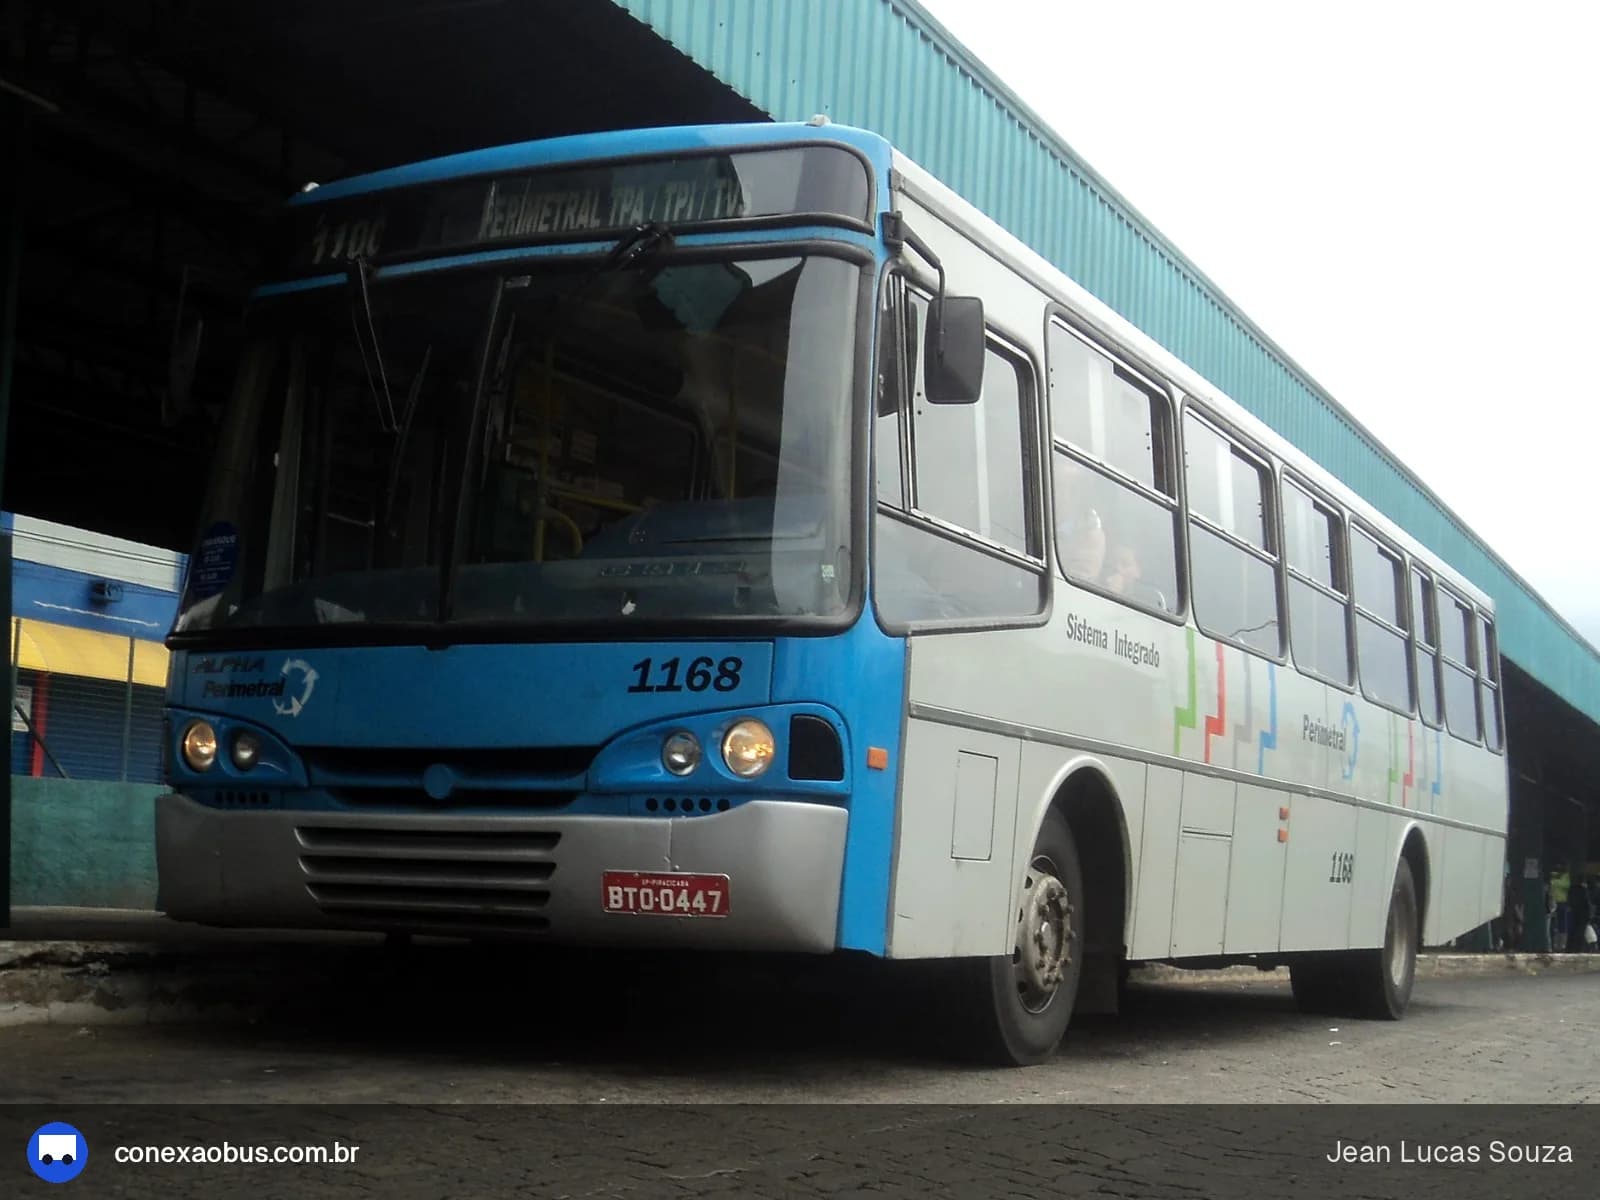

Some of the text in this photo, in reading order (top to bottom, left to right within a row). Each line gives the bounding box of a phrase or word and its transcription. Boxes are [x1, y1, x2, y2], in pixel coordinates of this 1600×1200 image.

[479, 187, 601, 240] PERIMETRAL
[609, 186, 646, 226] TPA
[1067, 613, 1161, 668] Sistema Integrado
[202, 676, 287, 698] Perimetral
[627, 656, 743, 693] 1168
[1302, 713, 1347, 751] Perimetral
[1329, 850, 1353, 884] 1168
